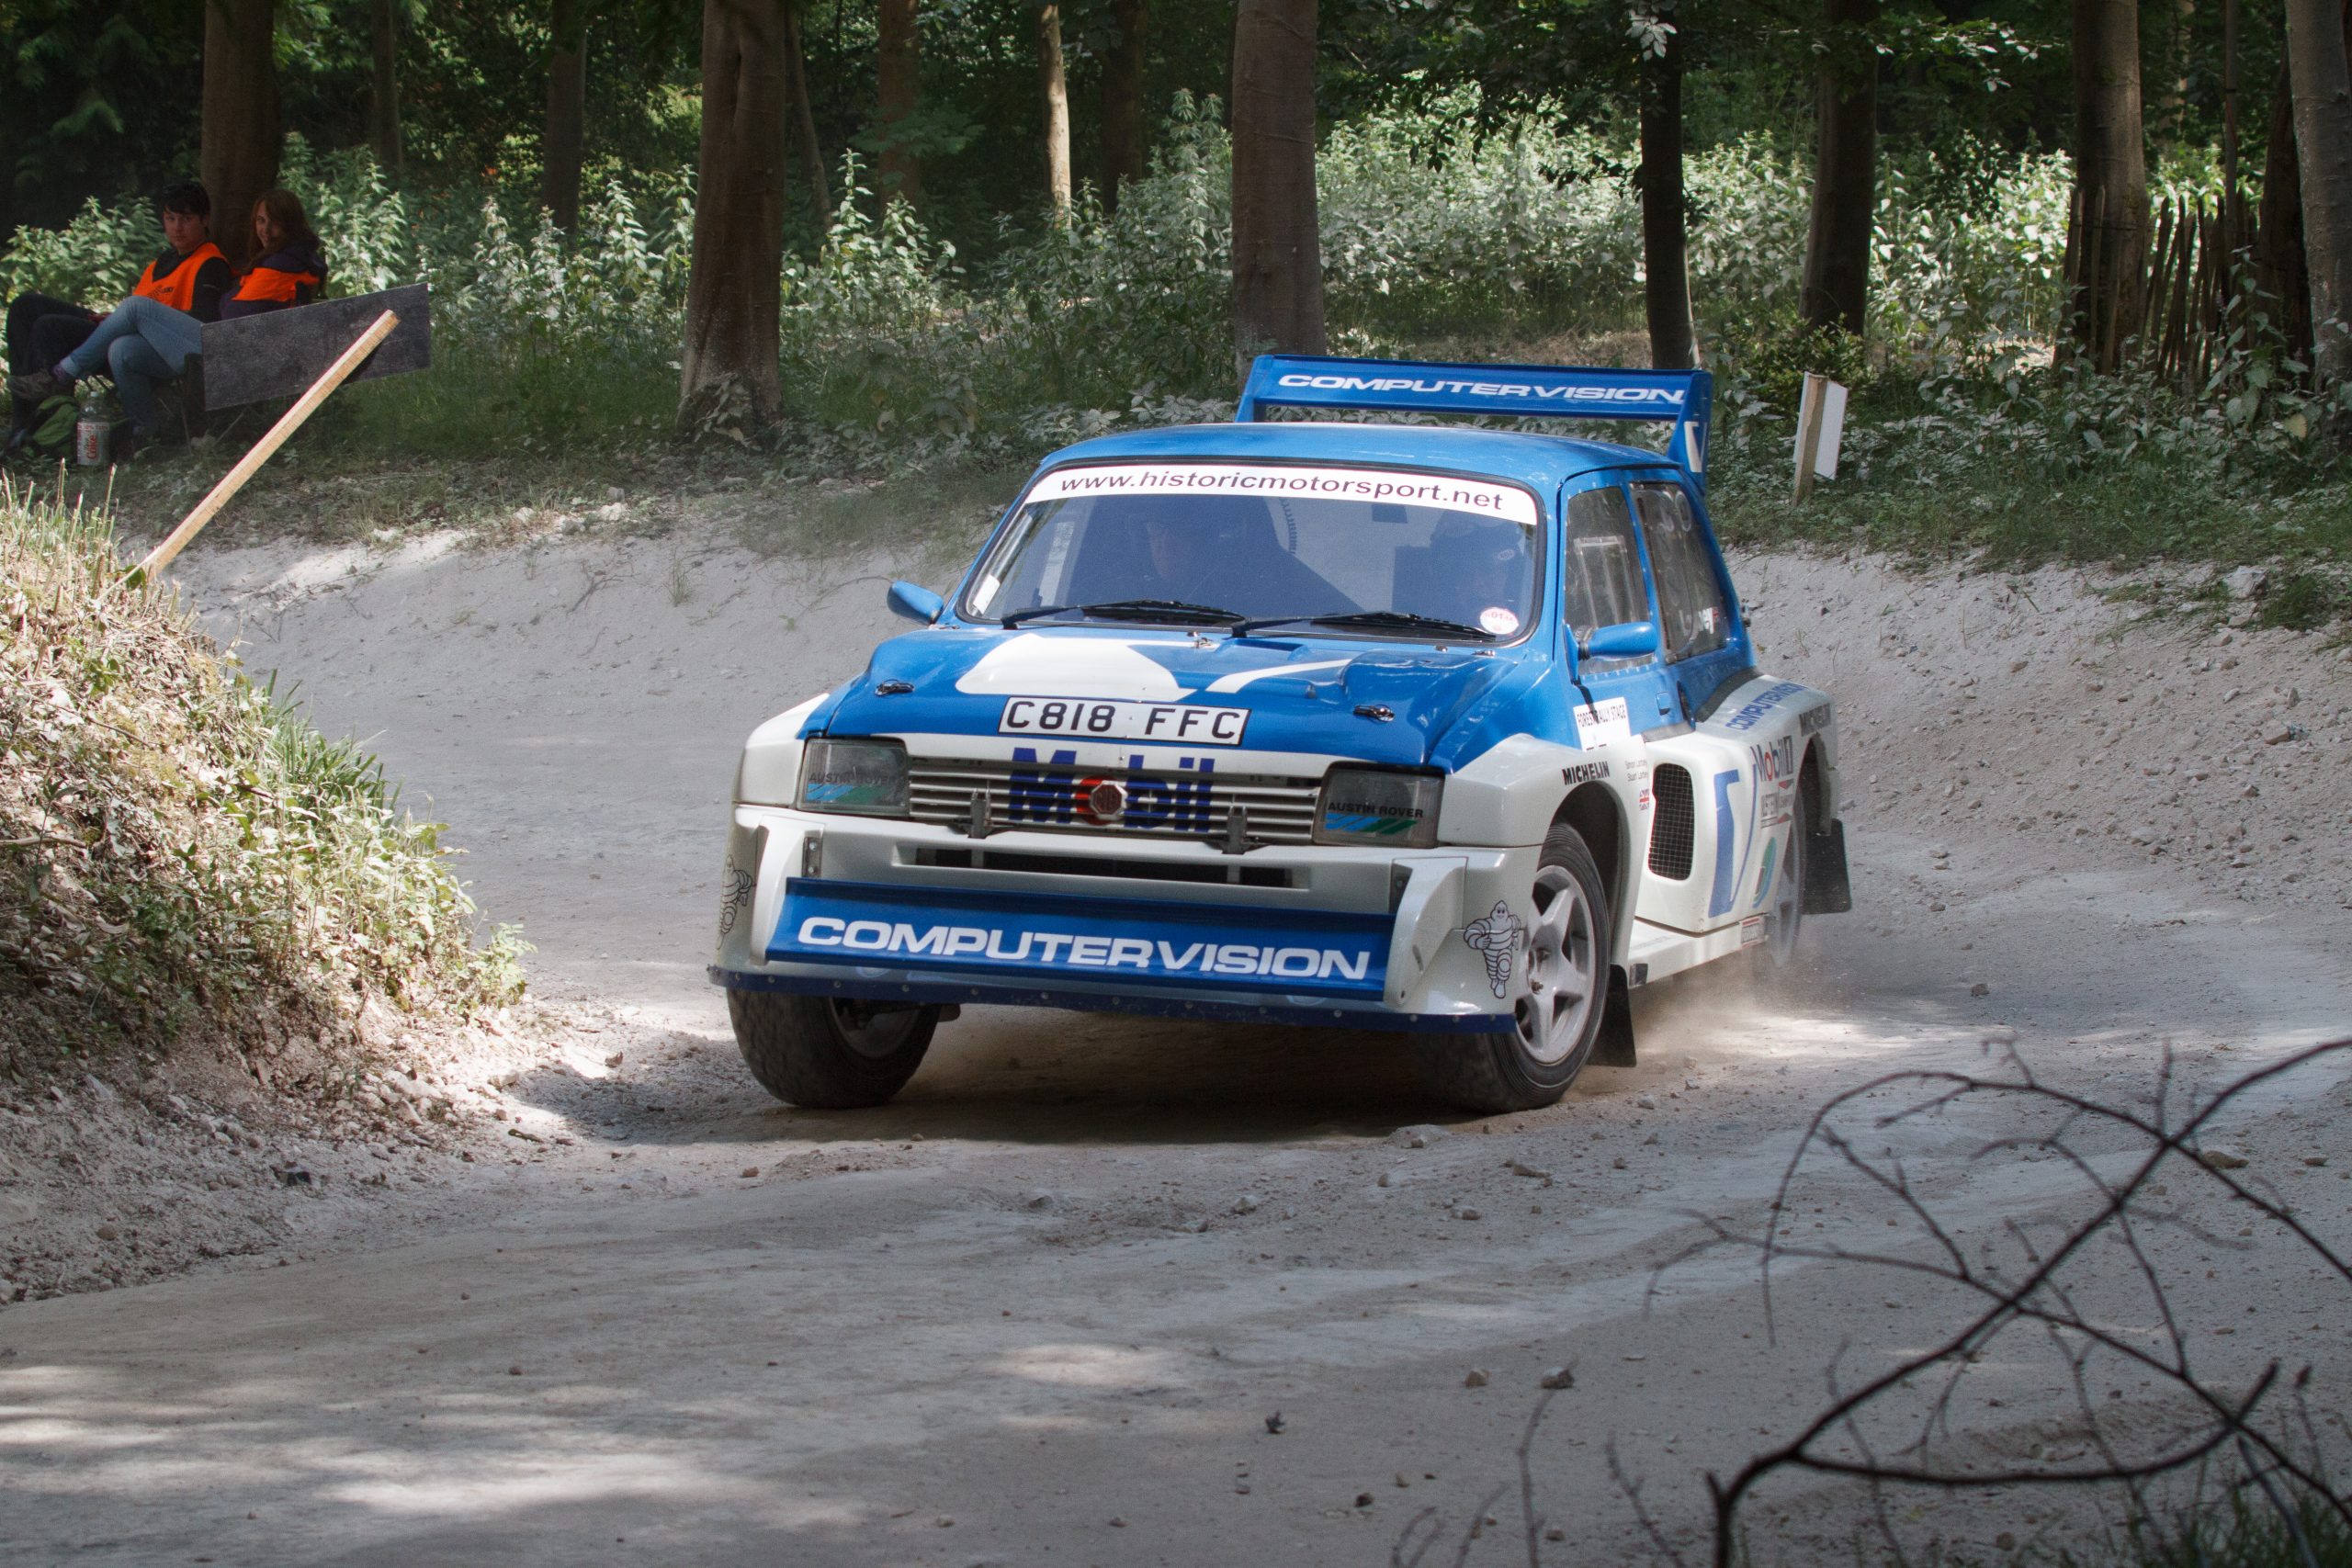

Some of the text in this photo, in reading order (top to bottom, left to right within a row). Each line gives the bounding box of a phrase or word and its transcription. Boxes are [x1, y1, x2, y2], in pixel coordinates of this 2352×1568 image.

[1278, 374, 1685, 402] COMPUTERVISION
[1060, 469, 1503, 511] www.historicmotorsport.net
[1006, 700, 1241, 739] C818 FFC
[1562, 761, 1610, 785] MICHELIN
[1329, 802, 1424, 818] AUSTIN ROVER
[797, 916, 1371, 980] COMPUTERVISION
